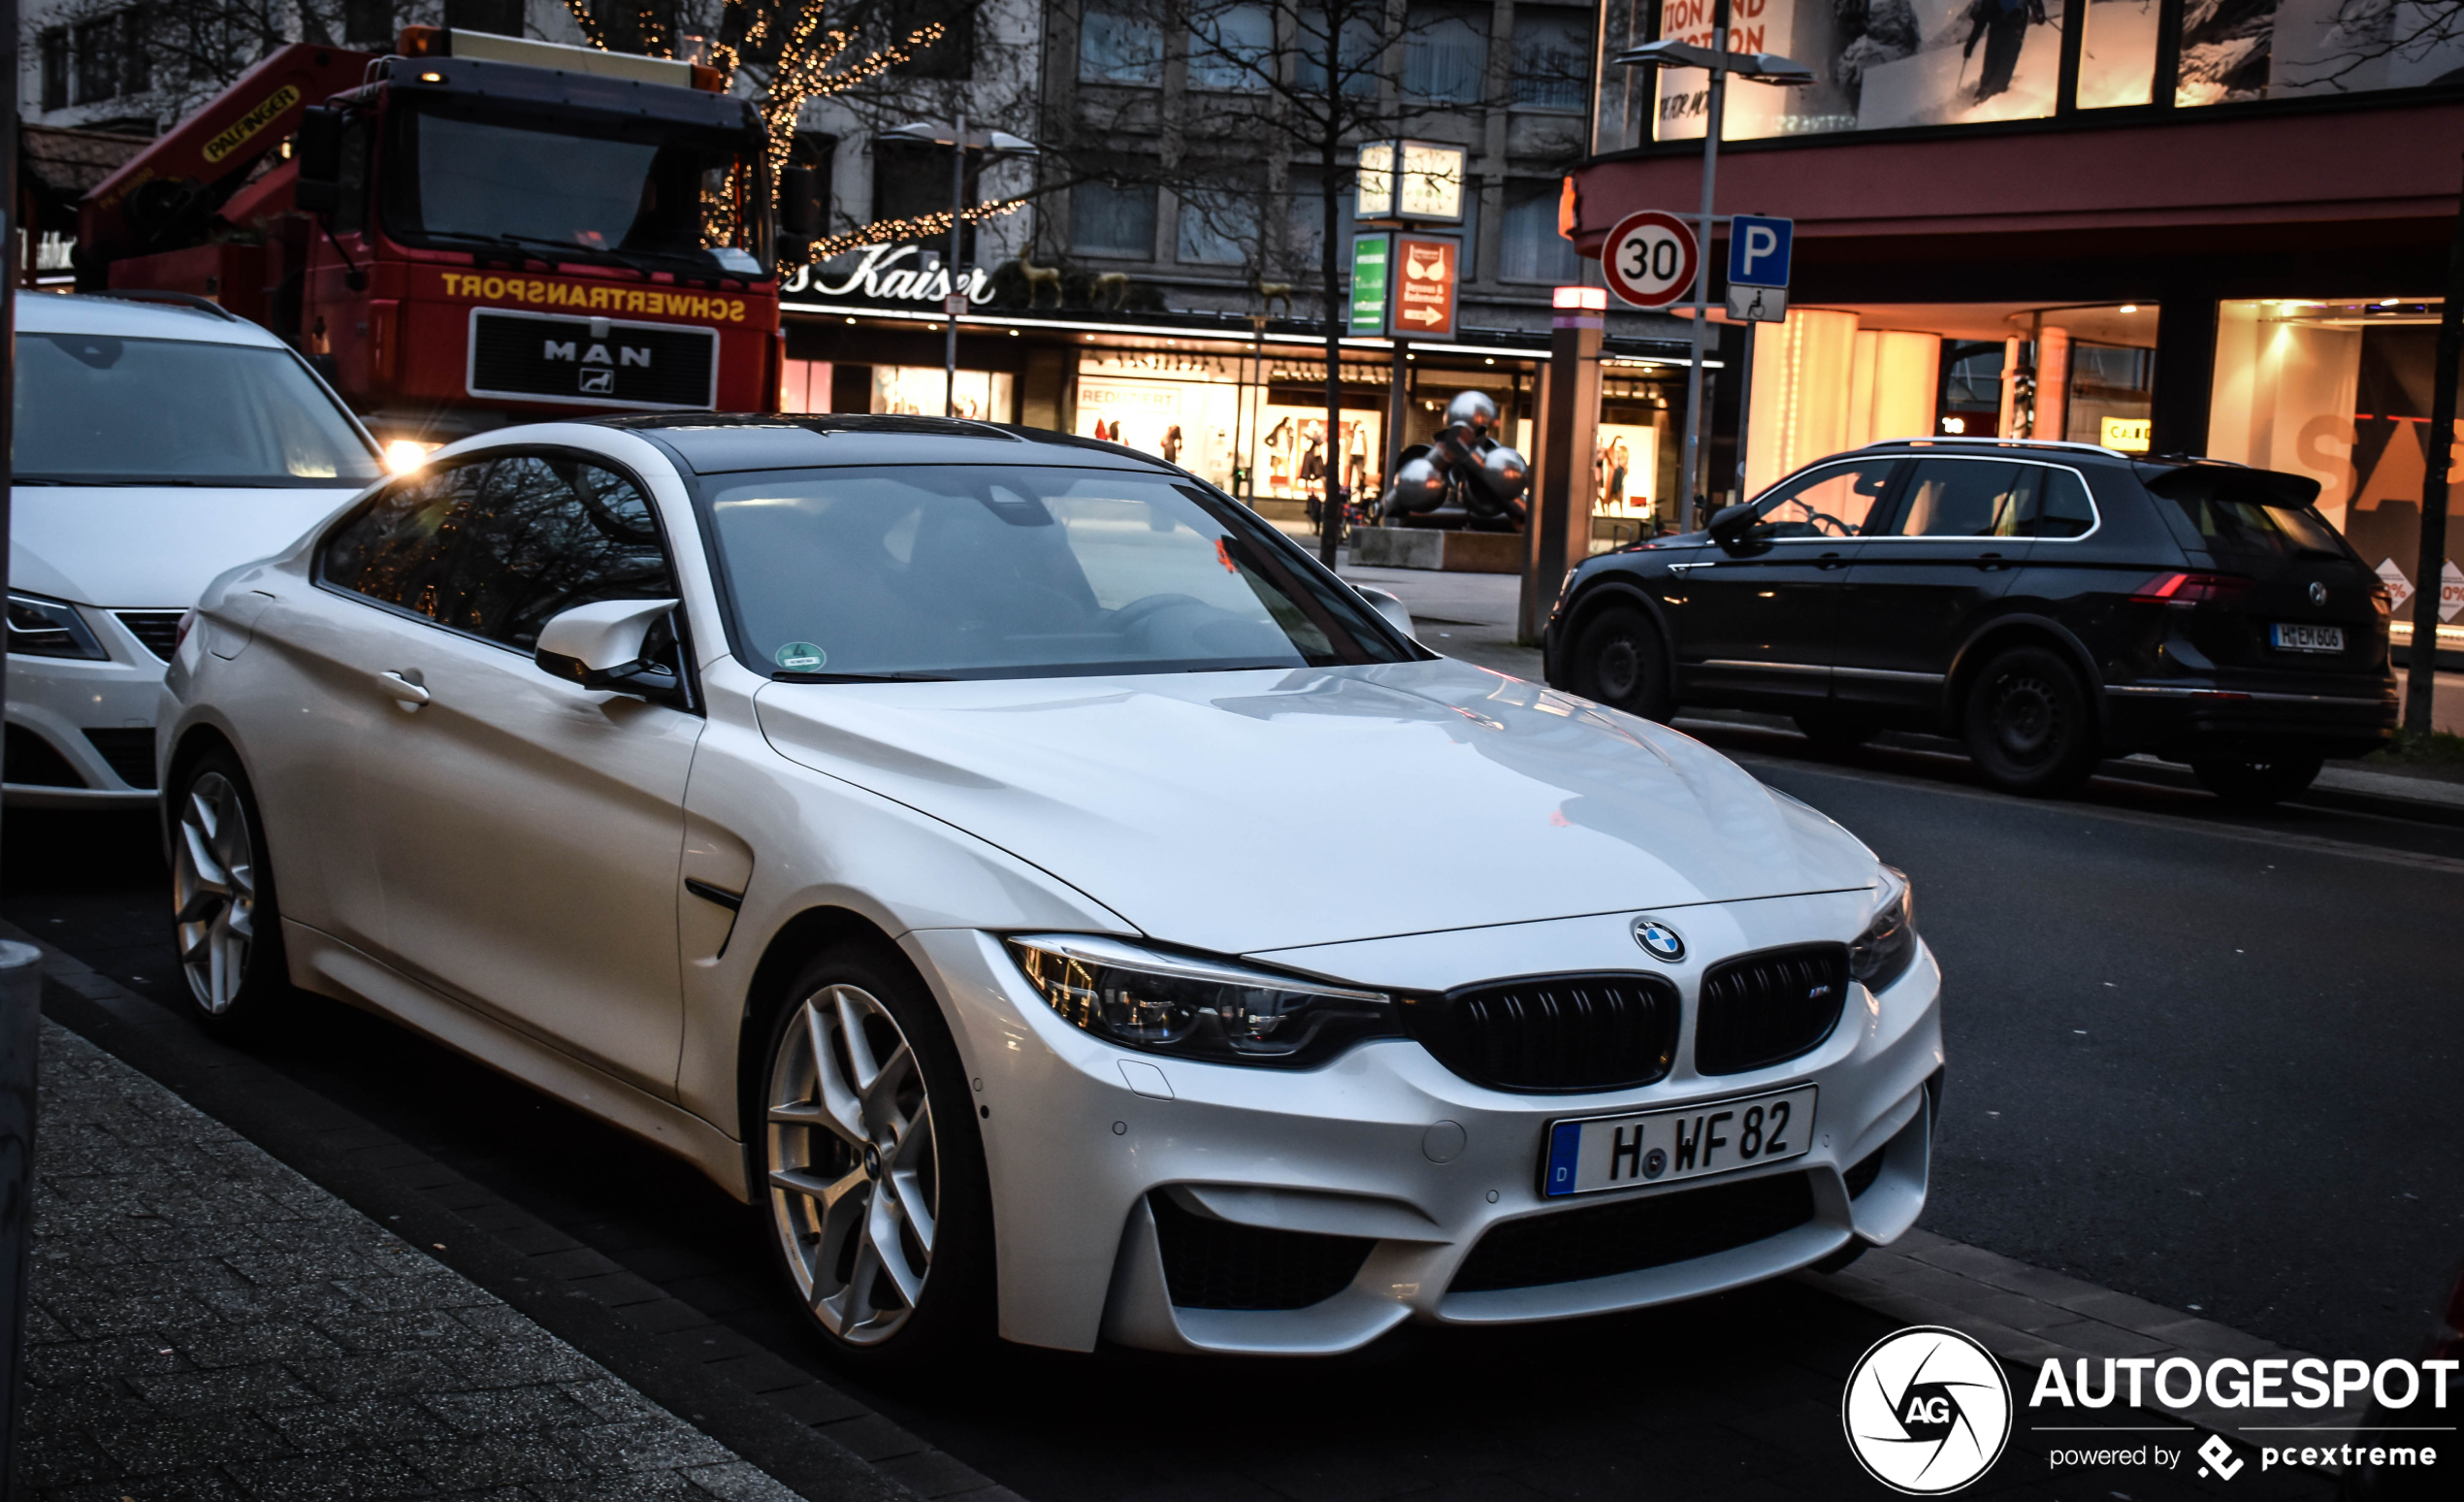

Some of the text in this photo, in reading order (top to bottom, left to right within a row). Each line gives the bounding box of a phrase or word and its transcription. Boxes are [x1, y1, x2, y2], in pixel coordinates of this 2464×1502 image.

[208, 88, 295, 158] PALFINGER
[1623, 238, 1677, 281] 30
[1743, 225, 1777, 276] P
[780, 243, 996, 305] s Kaiser
[544, 340, 651, 368] MAN
[1082, 389, 1173, 406] REDUZIERT
[794, 644, 807, 657] 4
[2281, 625, 2290, 644] H
[2318, 628, 2339, 647] 606
[1556, 1099, 1791, 1182] D H WF 82
